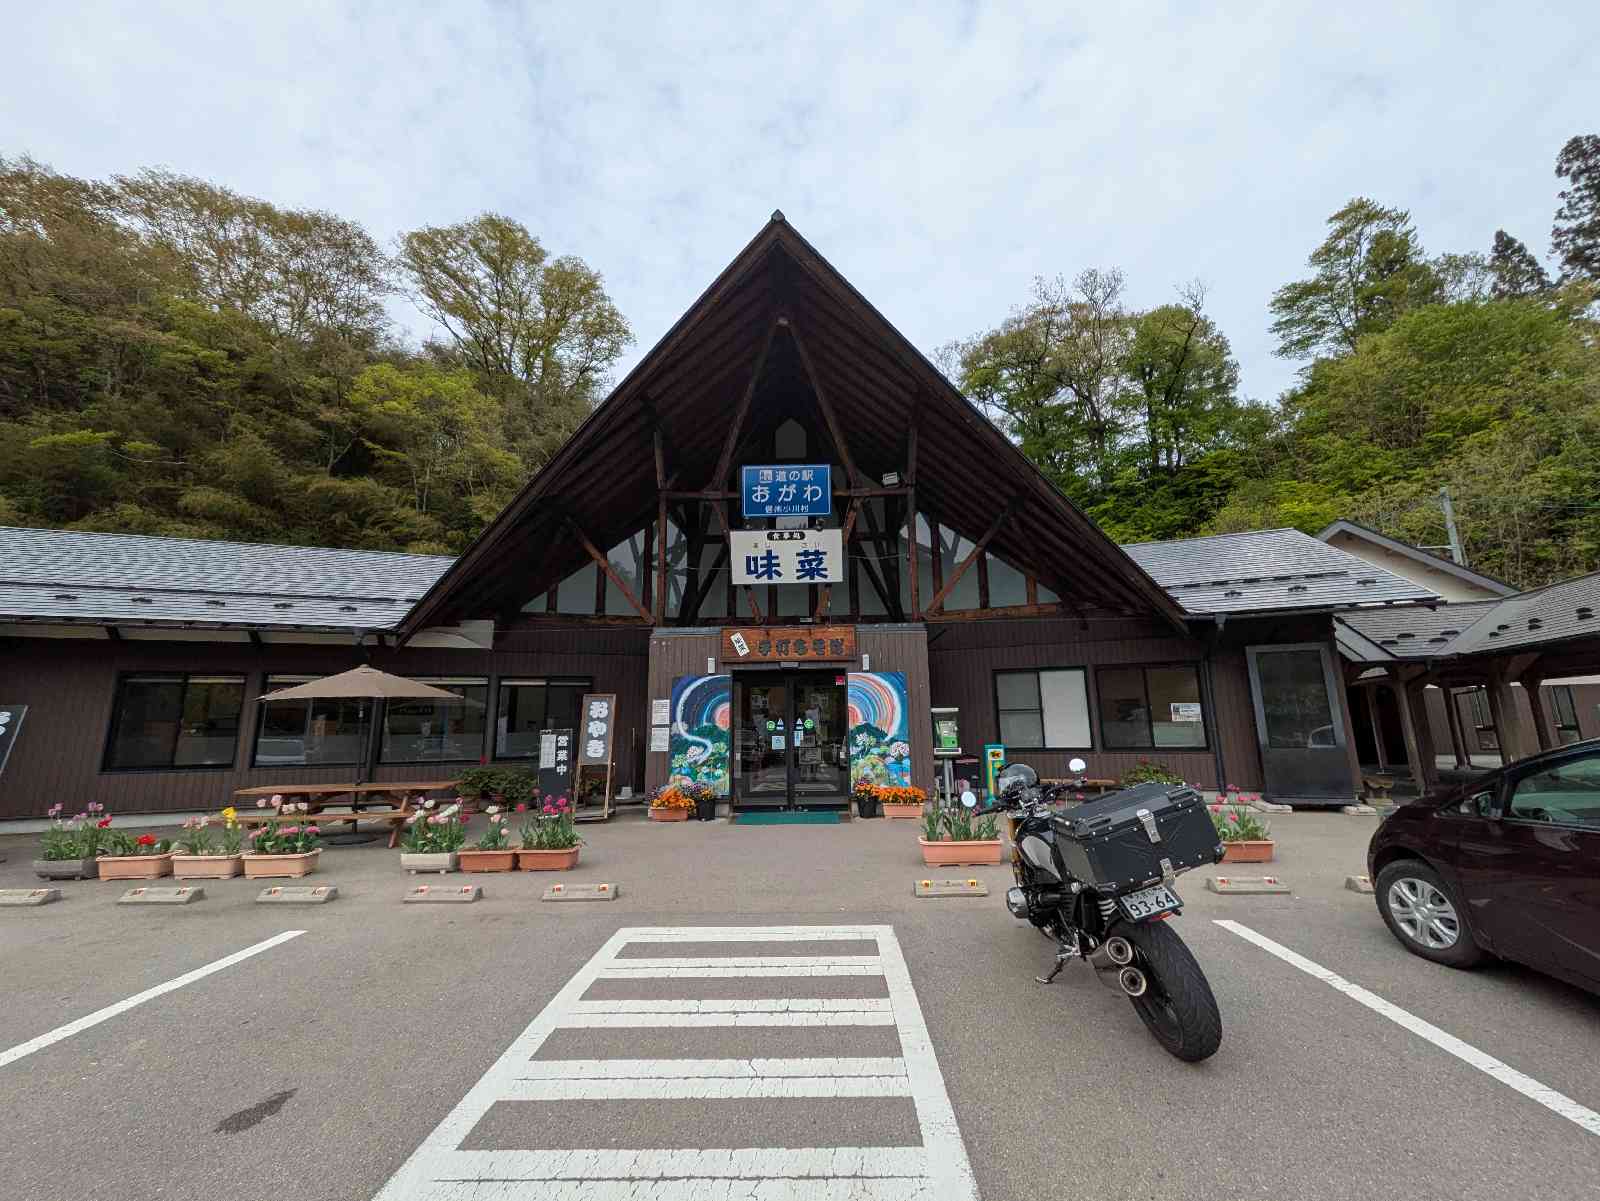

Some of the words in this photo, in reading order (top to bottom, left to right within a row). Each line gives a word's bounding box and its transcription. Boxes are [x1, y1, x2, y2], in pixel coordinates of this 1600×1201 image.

[775, 469, 814, 482] 道の駅
[751, 484, 822, 503] おがわ
[745, 549, 829, 581] 味菜
[556, 735, 569, 776] 営業中
